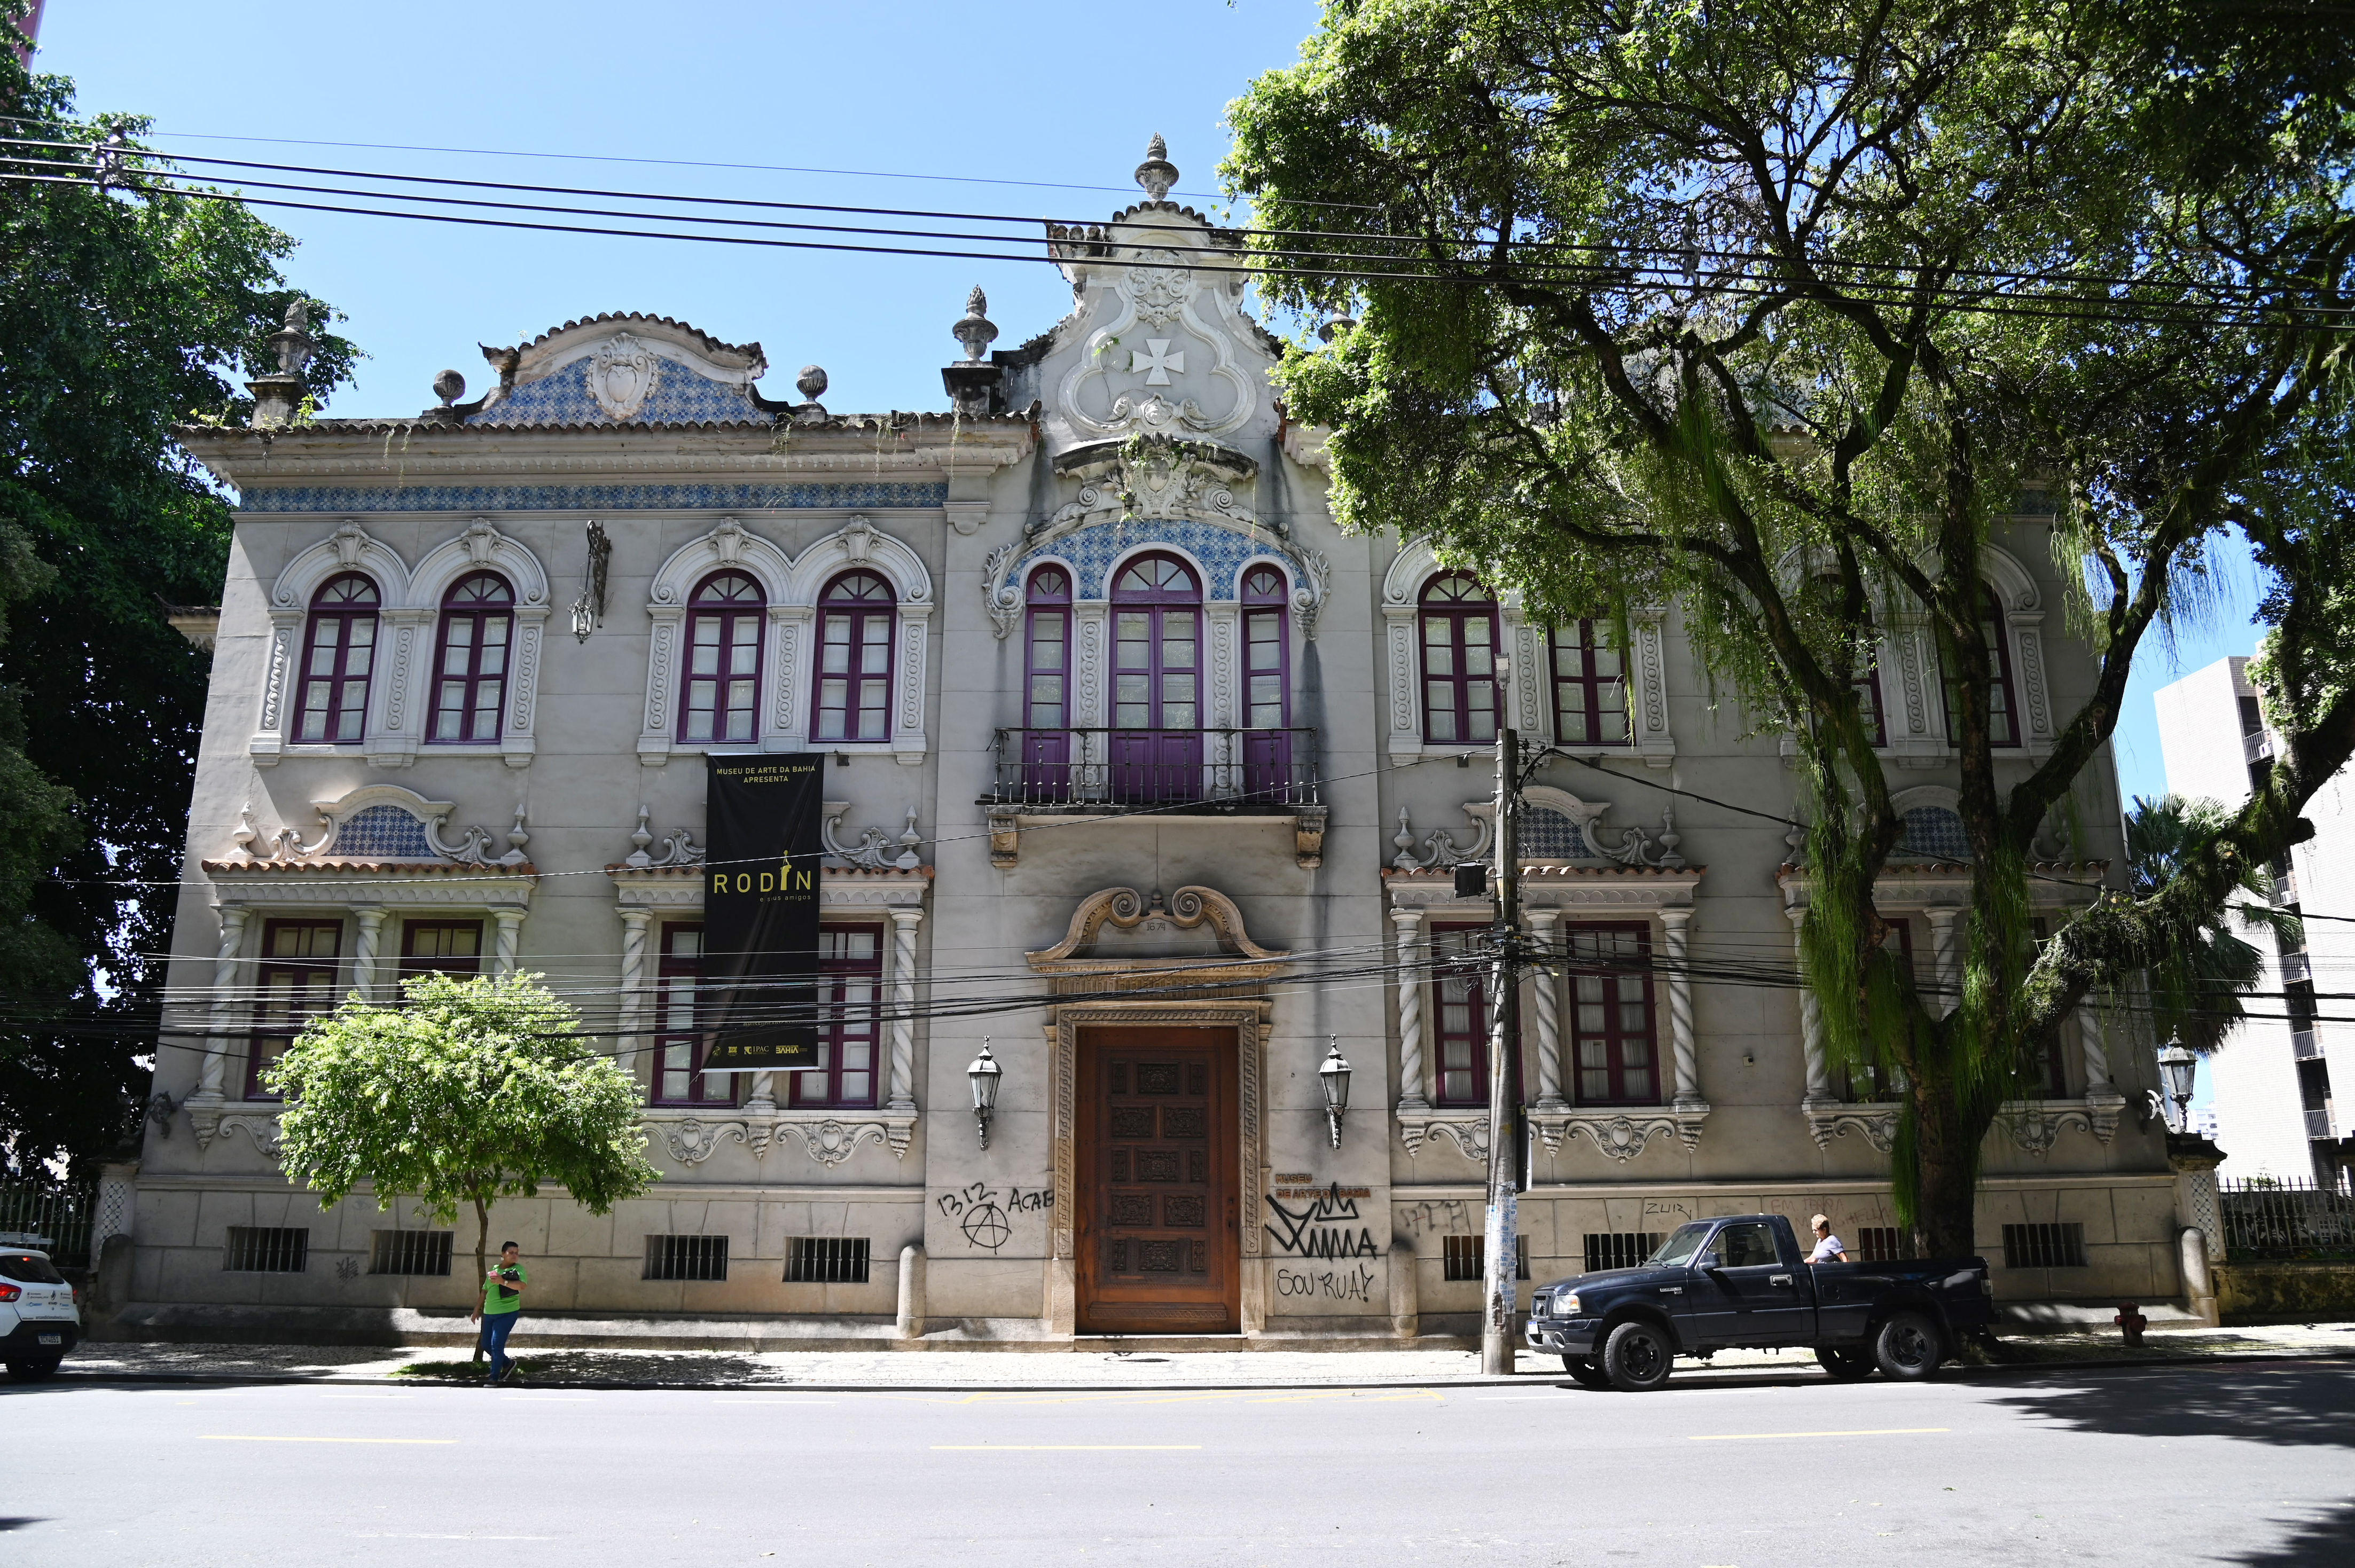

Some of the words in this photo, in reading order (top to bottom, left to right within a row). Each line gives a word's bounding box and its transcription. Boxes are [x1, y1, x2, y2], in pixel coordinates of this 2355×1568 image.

[714, 863, 811, 893] RODIN
[1147, 922, 1165, 931] 1674
[1276, 1174, 1312, 1184] MUSEU
[1276, 1189, 1292, 1199] DE
[1292, 1189, 1321, 1199] ARTE
[1339, 1188, 1371, 1198] BAHIA
[1277, 1269, 1314, 1296] SOU
